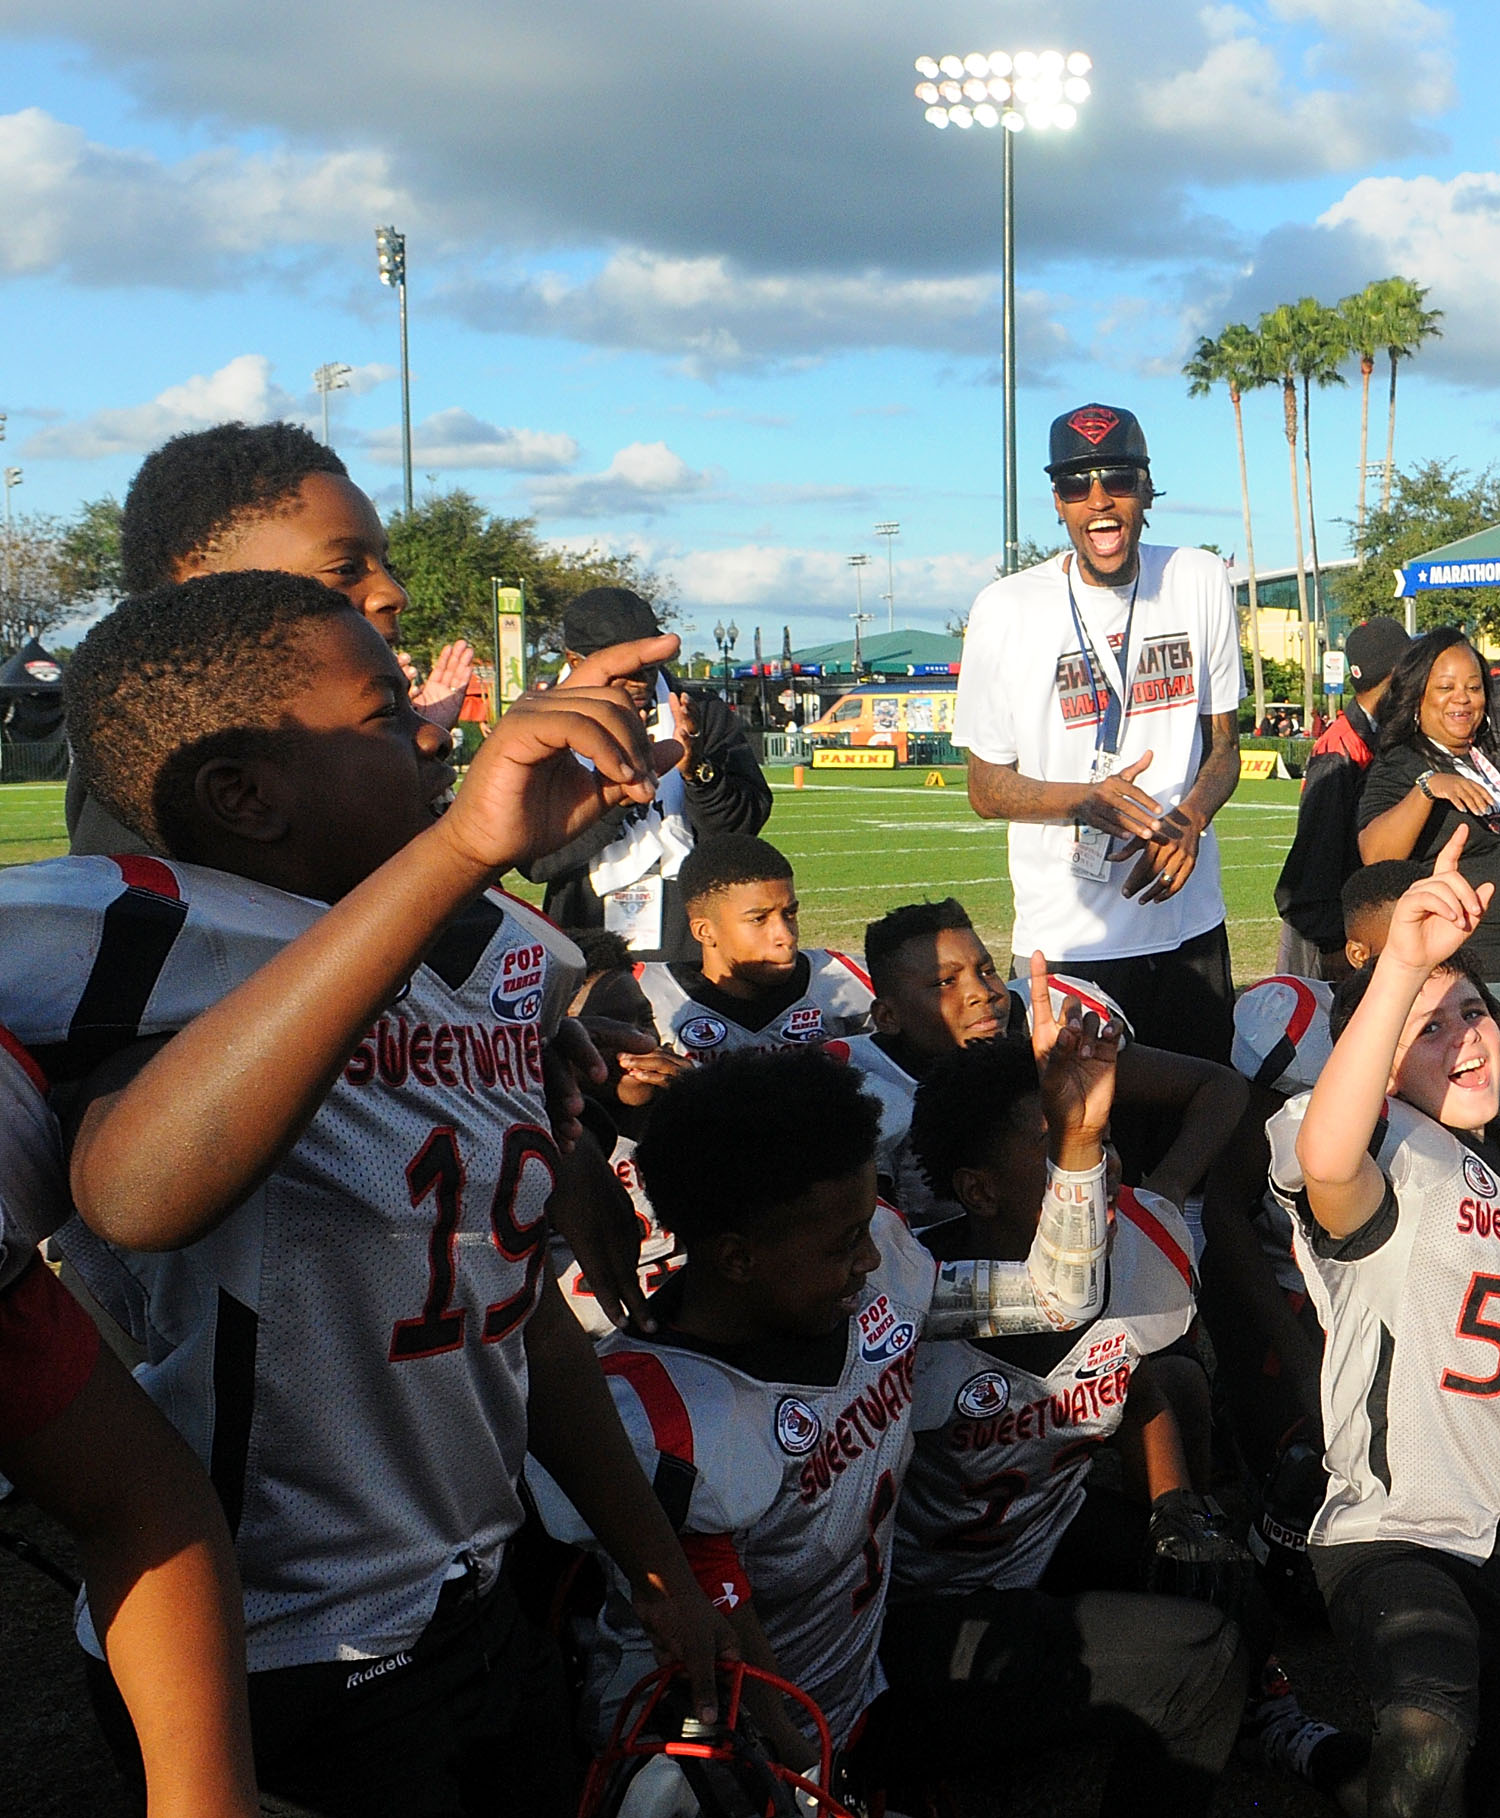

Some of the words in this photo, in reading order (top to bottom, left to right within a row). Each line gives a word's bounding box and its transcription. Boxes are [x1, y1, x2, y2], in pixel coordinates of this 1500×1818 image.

[504, 598, 517, 611] 17
[820, 754, 888, 764] PANINI
[503, 943, 545, 976] POP
[791, 1009, 821, 1024] POP
[343, 1015, 545, 1095] SWEETWATE
[389, 1122, 560, 1363] 19
[858, 1295, 889, 1334] POP
[866, 1314, 896, 1345] WARNER
[1088, 1333, 1126, 1359] POP
[951, 1363, 1132, 1452] SWEETWATER
[347, 1651, 408, 1690] Riddell
